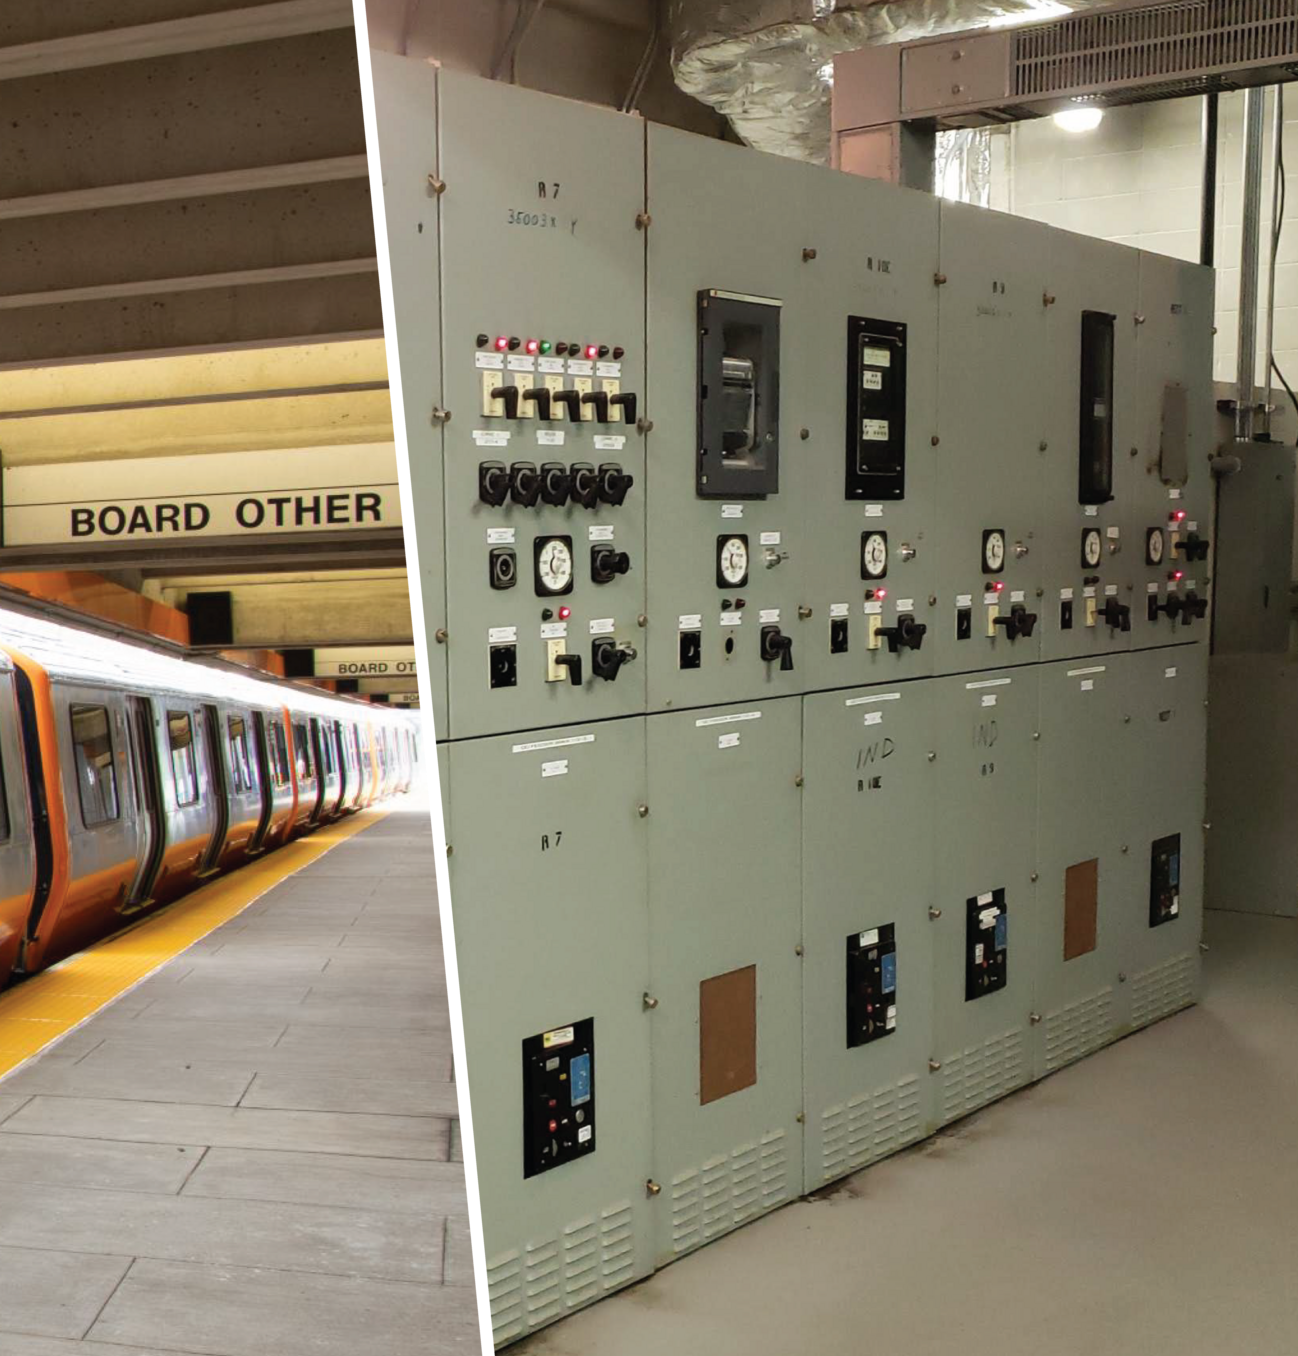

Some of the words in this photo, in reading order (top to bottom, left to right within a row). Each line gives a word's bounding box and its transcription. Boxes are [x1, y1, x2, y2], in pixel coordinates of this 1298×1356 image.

[553, 183, 560, 199] 7
[71, 502, 210, 537] BOARD
[236, 492, 382, 529] OTHER
[338, 663, 388, 674] BOARD
[856, 737, 895, 771] IND
[541, 834, 550, 852] R
[555, 831, 562, 847] 7
